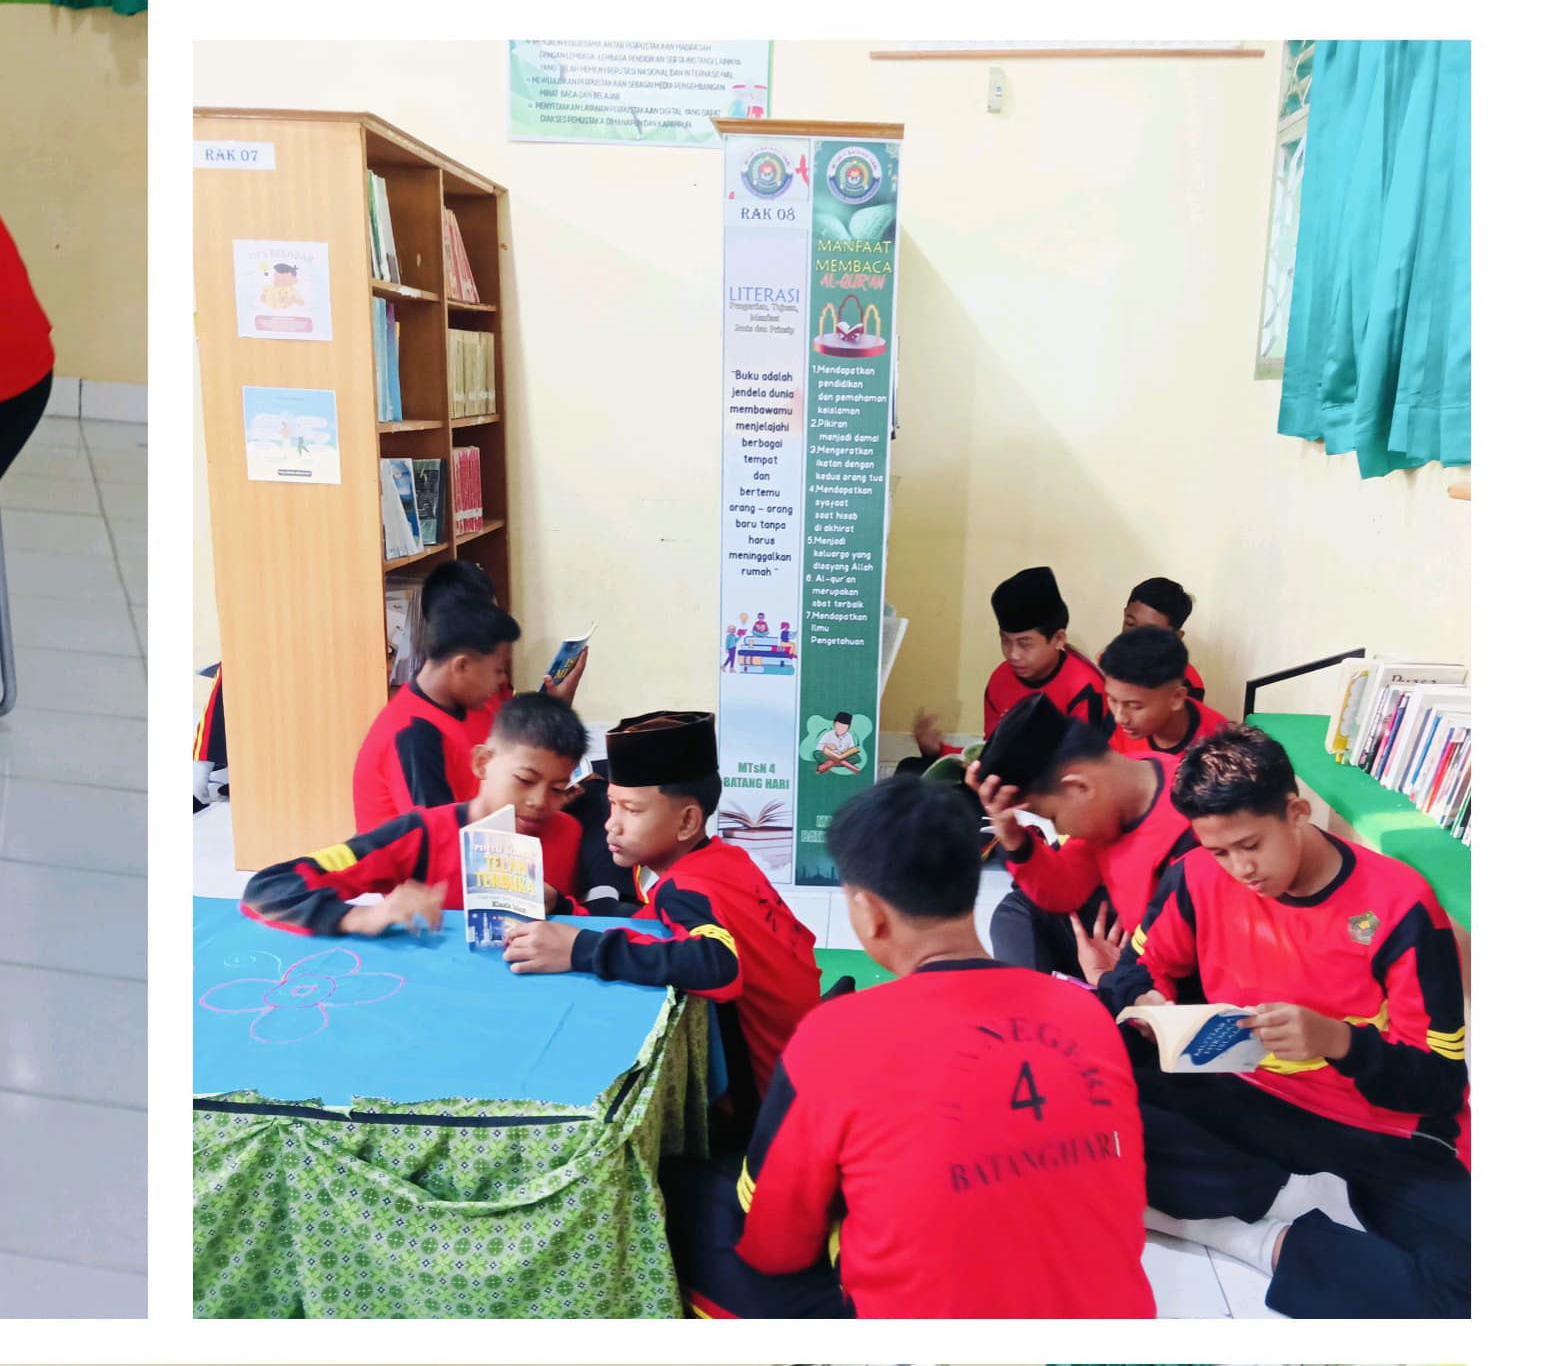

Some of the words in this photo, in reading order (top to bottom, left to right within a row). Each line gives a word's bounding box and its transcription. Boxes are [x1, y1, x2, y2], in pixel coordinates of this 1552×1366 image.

[205, 148, 236, 162] RAK
[239, 149, 259, 162] 07
[741, 207, 773, 220] RAK
[776, 208, 796, 221] 08
[817, 239, 893, 254] MANFAAT
[815, 259, 893, 274] MEMBACA
[729, 286, 800, 304] LITERASI
[762, 371, 793, 382] adalah
[818, 380, 863, 389] pendidikan
[731, 387, 767, 399] jendela
[768, 388, 794, 399] dunia
[818, 393, 834, 402] dan
[835, 394, 887, 404] pemahaman
[730, 404, 793, 416] membawamu
[736, 421, 790, 433] menjelajahi
[742, 437, 783, 450] berbagai
[819, 433, 852, 443] menjadi
[854, 433, 880, 443] damai
[744, 454, 778, 466] tempat
[844, 460, 875, 471] dengan
[753, 471, 770, 481] dan
[815, 472, 841, 481] kedua
[842, 474, 868, 483] orang
[869, 473, 884, 483] tua
[739, 487, 781, 497] bertemu
[729, 504, 756, 515] orang
[766, 506, 793, 516] orang
[814, 512, 834, 520] saat
[835, 511, 858, 521] hisab
[735, 519, 757, 529] baru
[760, 520, 786, 532] tanpa
[814, 524, 823, 533] di
[824, 524, 855, 533] akhirat
[748, 535, 776, 546] harus
[729, 551, 792, 563] meninggalkan
[812, 549, 850, 559] keluarga
[851, 551, 872, 561] yang
[741, 567, 772, 577] rumah
[812, 561, 850, 572] disayang
[850, 562, 874, 572] Allah
[812, 588, 859, 597] merupakan
[811, 599, 832, 608] obat
[833, 599, 864, 609] terbaik
[811, 623, 830, 633] Ilmu
[810, 636, 865, 647] Pengetahuan
[738, 762, 769, 774] MTsN
[768, 762, 776, 774] 4
[723, 776, 764, 789] BATANG
[764, 778, 790, 790] HARI
[1010, 1060, 1047, 1122] 4
[951, 1130, 1121, 1193] BATANGHARI
